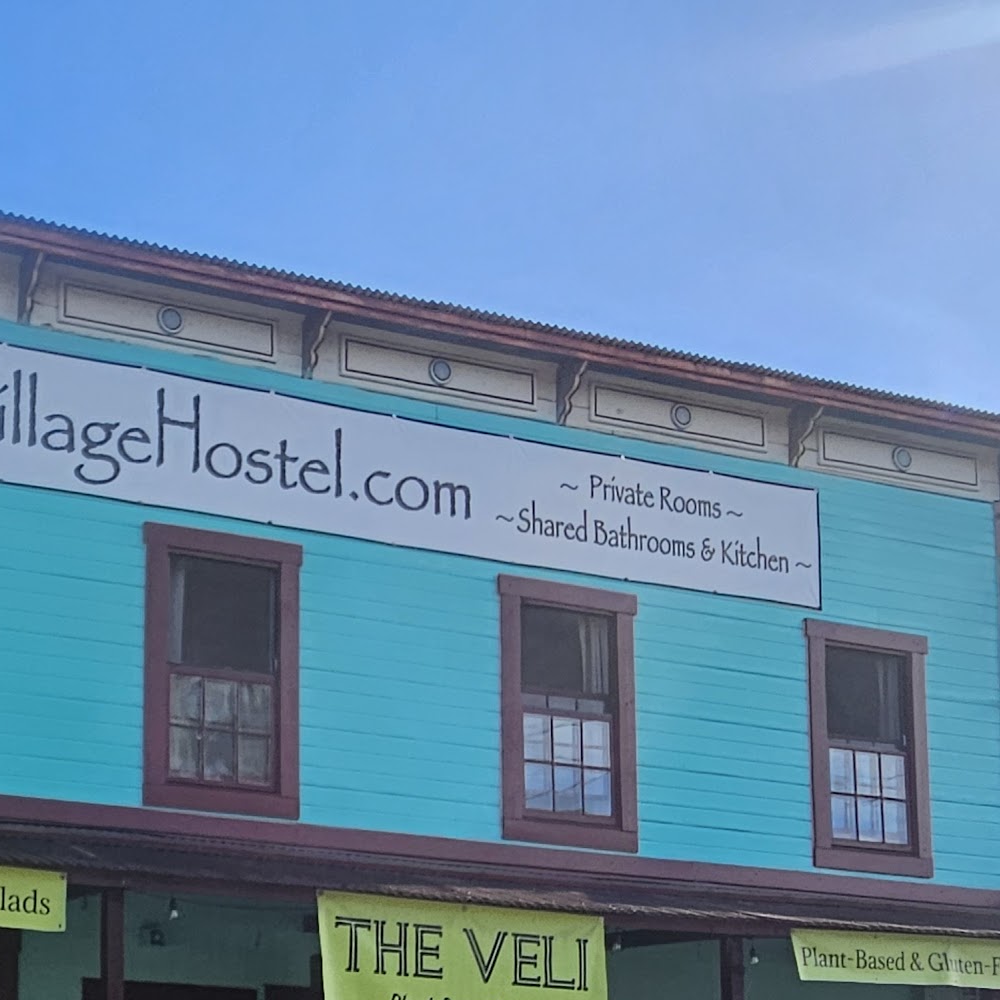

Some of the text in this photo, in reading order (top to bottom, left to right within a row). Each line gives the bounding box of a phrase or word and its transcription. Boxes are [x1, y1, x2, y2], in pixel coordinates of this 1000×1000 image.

[589, 474, 655, 508] Private
[660, 486, 722, 519] Rooms
[516, 500, 588, 543] Shared
[593, 516, 696, 559] Bathrooms
[700, 537, 716, 562] &
[721, 536, 790, 573] Kitchen
[334, 915, 589, 991] THE VELI
[800, 946, 905, 972] Plant-Based
[909, 951, 925, 972] &
